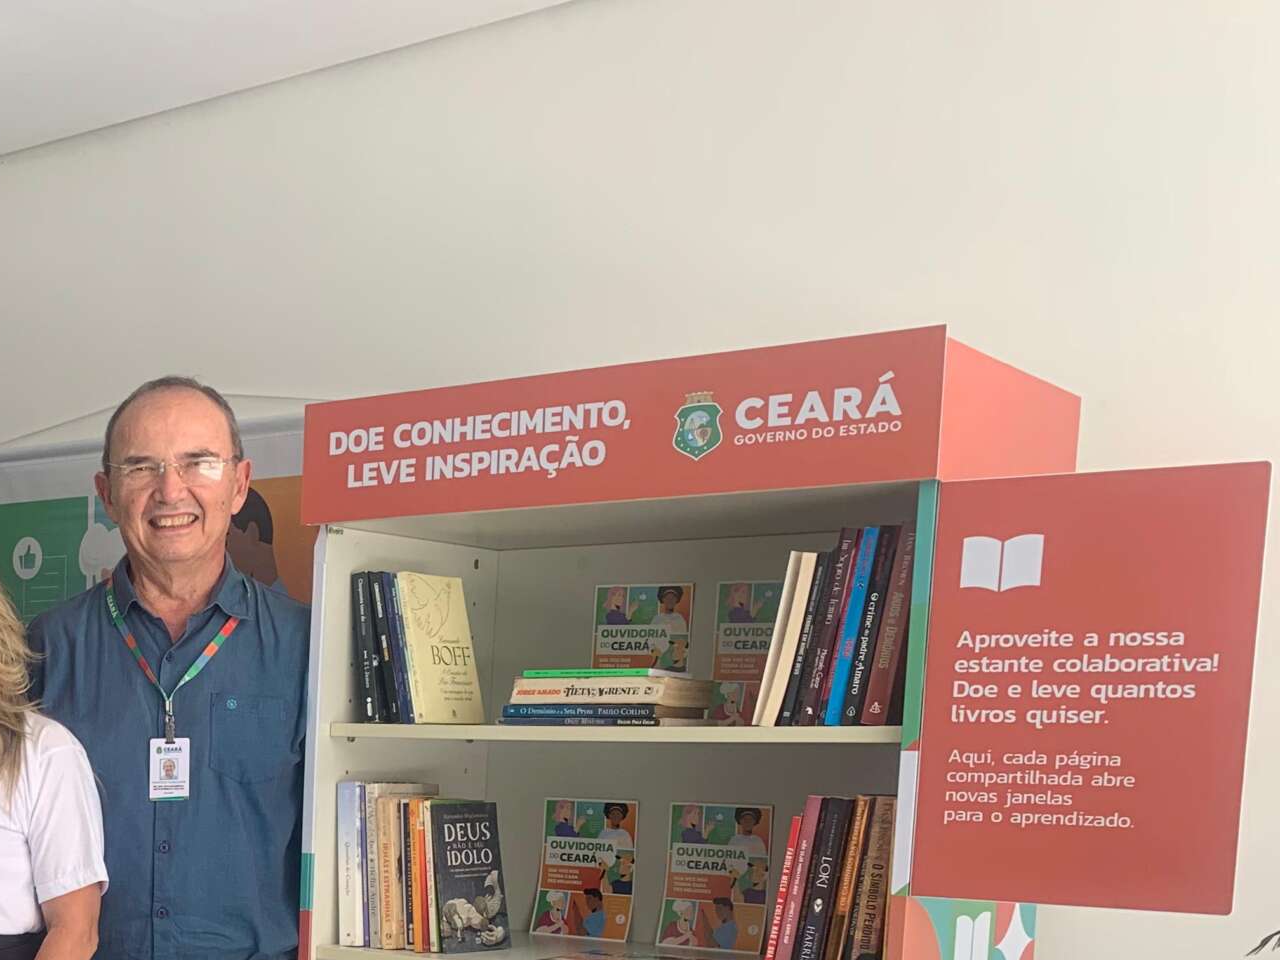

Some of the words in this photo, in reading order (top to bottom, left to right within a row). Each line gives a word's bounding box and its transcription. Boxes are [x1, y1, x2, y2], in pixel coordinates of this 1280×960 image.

[734, 370, 903, 431] CEARÁ
[328, 427, 385, 456] DOE
[392, 399, 632, 450] CONHECIMENTO,
[733, 428, 808, 446] GOVERNO
[811, 426, 834, 441] DO
[838, 419, 903, 439] ESTADO
[346, 458, 417, 489] LEVE
[424, 435, 607, 482] INSPIRAÇÃO
[865, 602, 879, 631] crime
[601, 627, 668, 640] OUVIDORIA
[723, 626, 774, 638] OUVIDO
[956, 629, 1074, 653] Aproveite
[1083, 632, 1099, 647] a
[1108, 630, 1185, 647] nossa
[610, 638, 650, 651] CEARÁ
[858, 635, 870, 661] padre
[430, 644, 471, 667] BOFF
[954, 655, 1044, 673] estante
[1052, 653, 1220, 673] colaborativa!
[851, 660, 866, 696] Amaro
[952, 679, 998, 699] Doe
[1006, 683, 1022, 699] e
[1030, 679, 1081, 699] leve
[1089, 680, 1197, 704] quantos
[620, 706, 650, 716] COELHO
[950, 704, 1017, 724] livros
[1025, 706, 1109, 729] quiser.
[948, 749, 996, 768] Aqui,
[1002, 749, 1048, 766] cada
[1055, 749, 1121, 770] página
[946, 769, 1084, 790] compartilhada
[1090, 772, 1136, 788] abre
[945, 790, 998, 805] novas
[1004, 789, 1073, 808] janelas
[943, 809, 984, 826] para
[990, 811, 1003, 823] o
[1009, 810, 1135, 829] aprendizado.
[443, 821, 491, 842] DEUS
[446, 845, 493, 866] ÍDOLO
[550, 839, 614, 853] OUVIDORIA
[676, 846, 747, 861] OUVIDORIA
[560, 851, 598, 864] CEARÁ
[686, 859, 728, 872] CEARÁ
[815, 855, 833, 889] LOKI
[860, 911, 877, 951] PERDIDO
